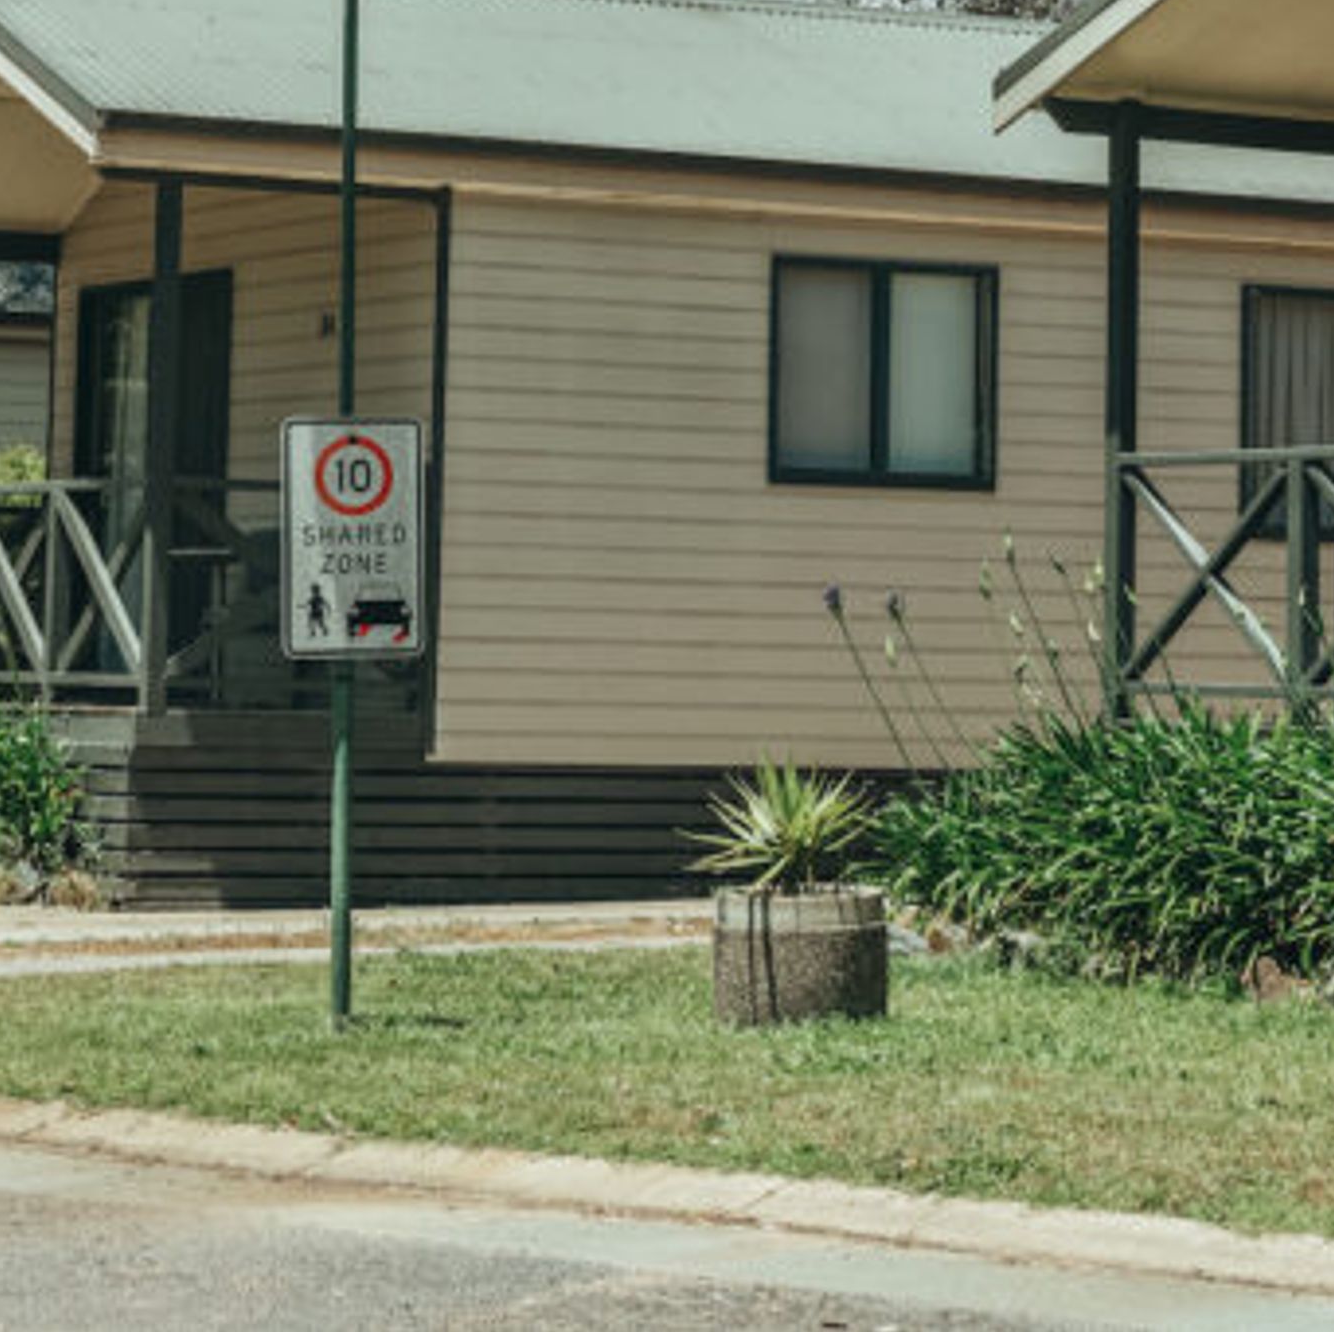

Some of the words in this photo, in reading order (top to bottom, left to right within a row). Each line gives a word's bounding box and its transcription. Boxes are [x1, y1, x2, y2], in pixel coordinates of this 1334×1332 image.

[335, 459, 371, 493] 10
[302, 522, 406, 547] SHARED
[320, 553, 388, 575] ZONE
